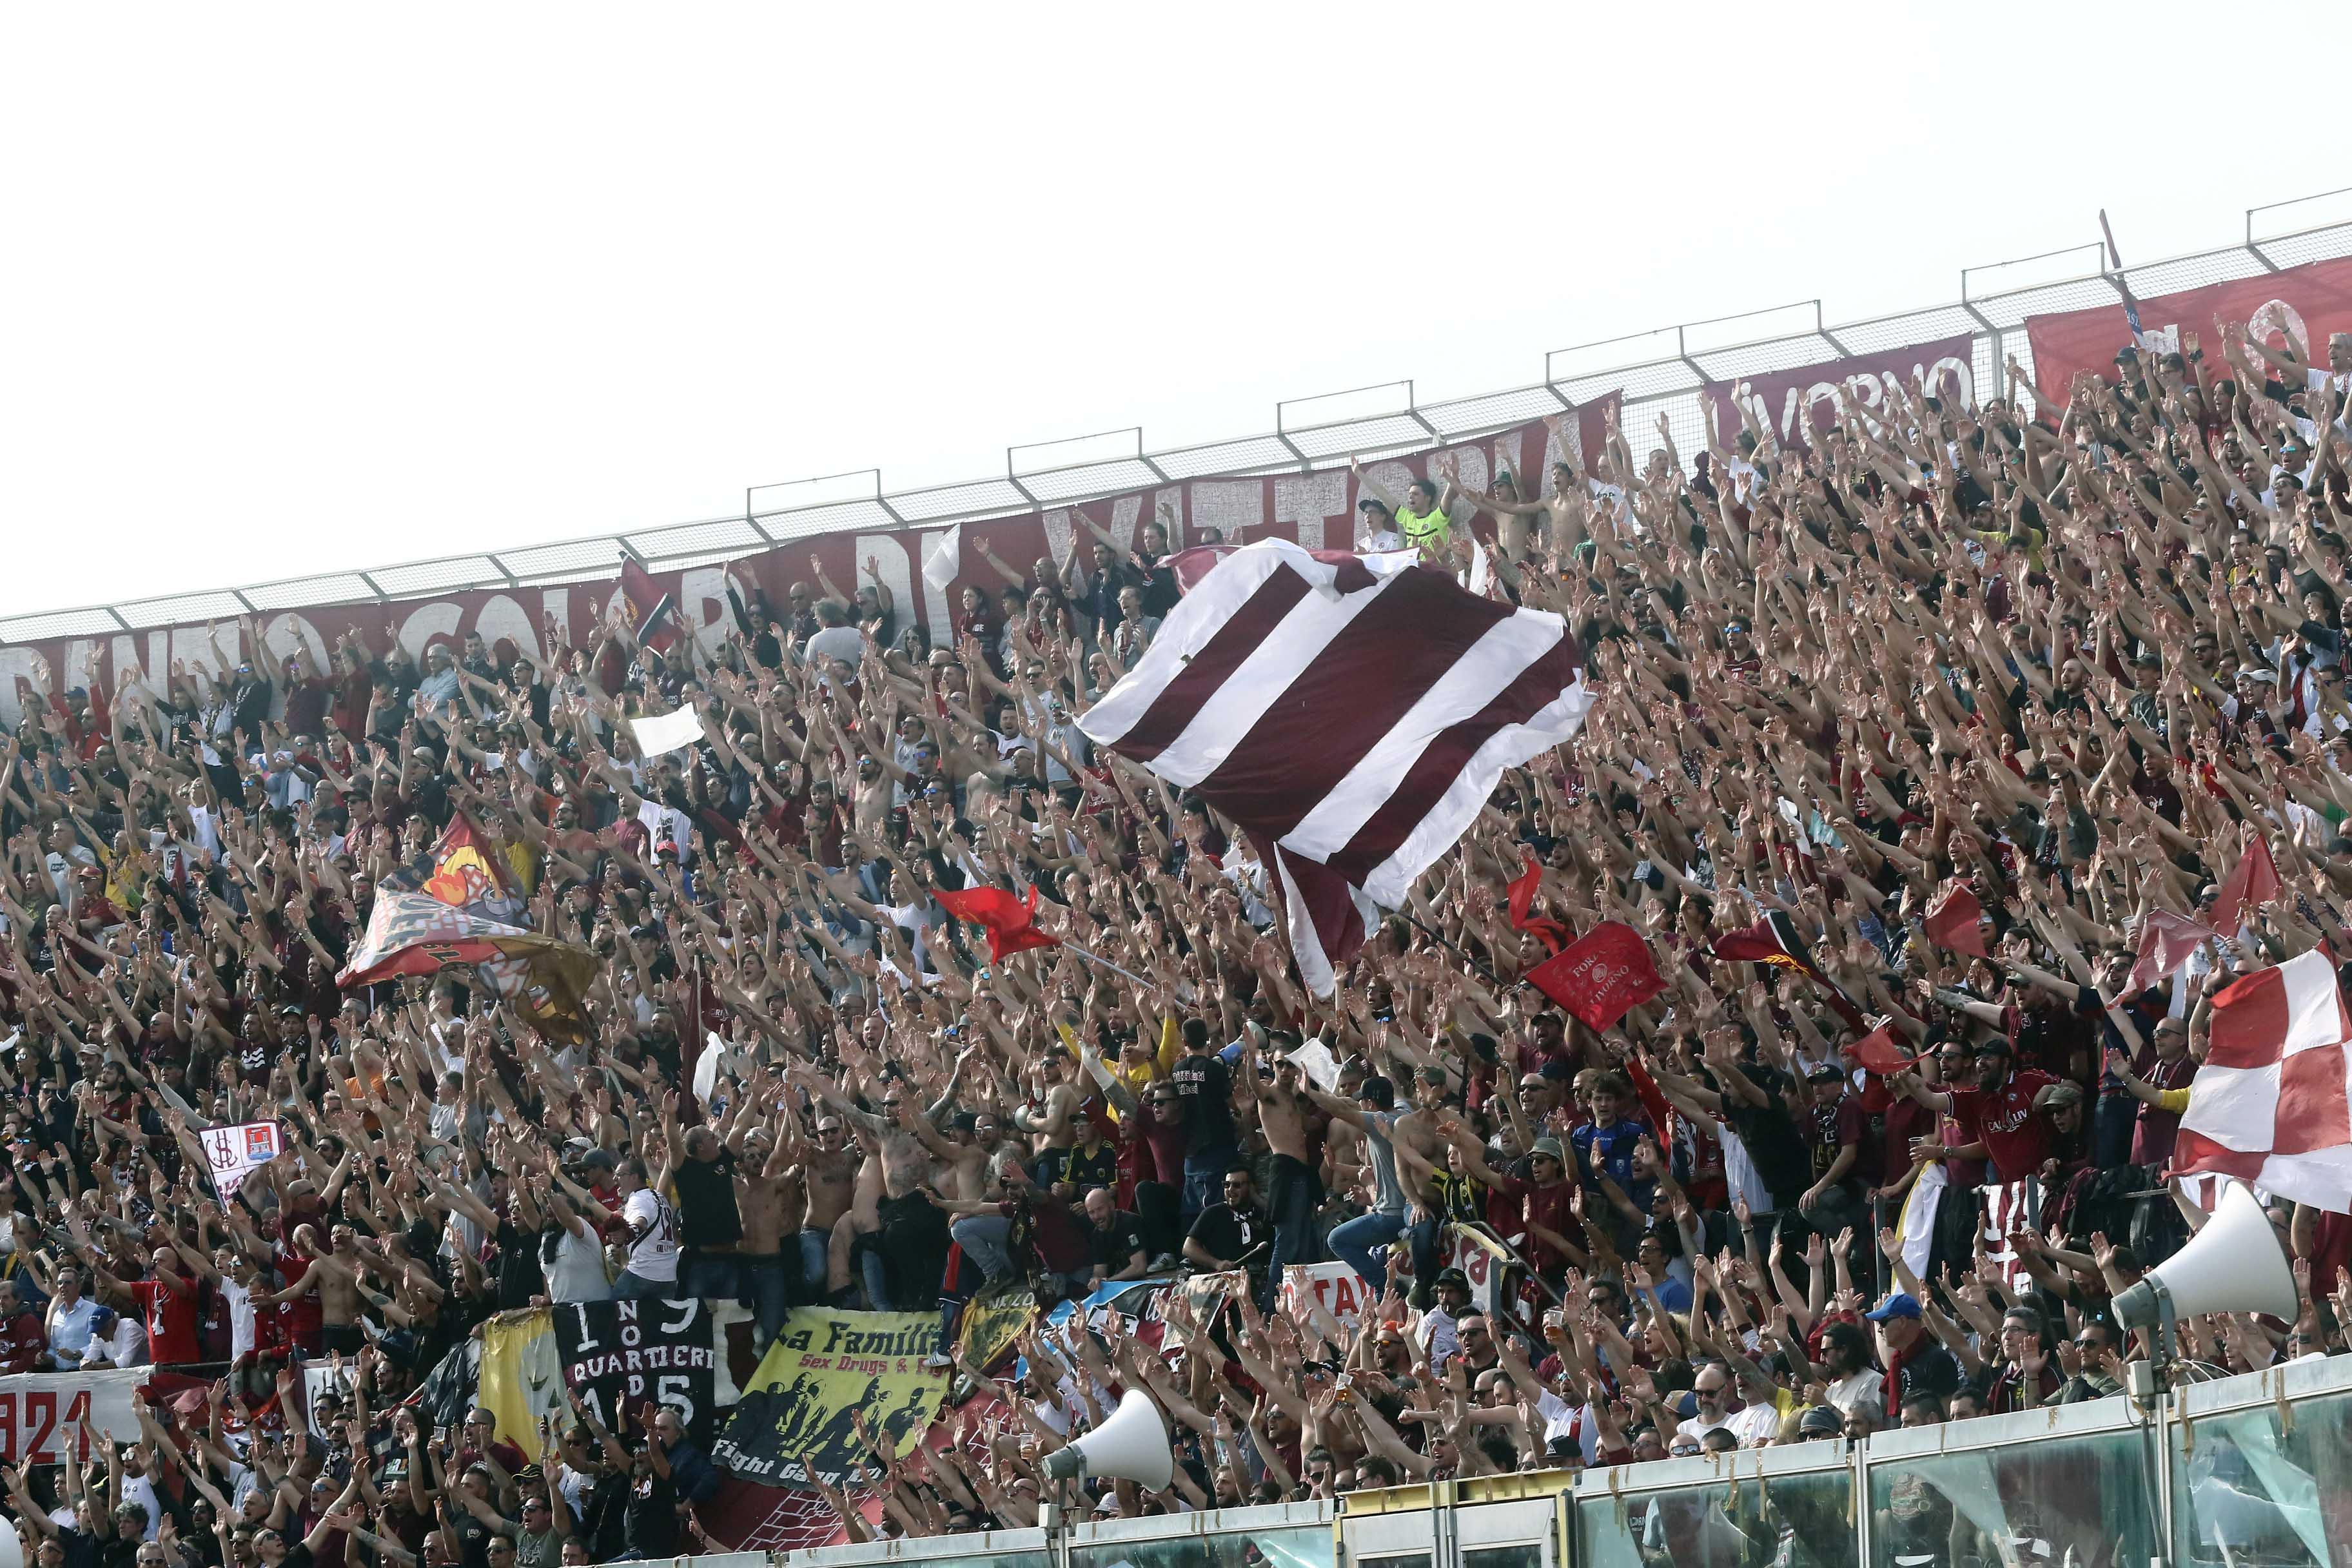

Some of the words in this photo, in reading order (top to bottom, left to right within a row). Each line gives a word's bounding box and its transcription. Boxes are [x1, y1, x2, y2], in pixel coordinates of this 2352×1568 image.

[798, 1353, 832, 1369] Sex
[836, 1355, 888, 1377] Drugs
[897, 1357, 907, 1373] &
[711, 1438, 774, 1472] Fight
